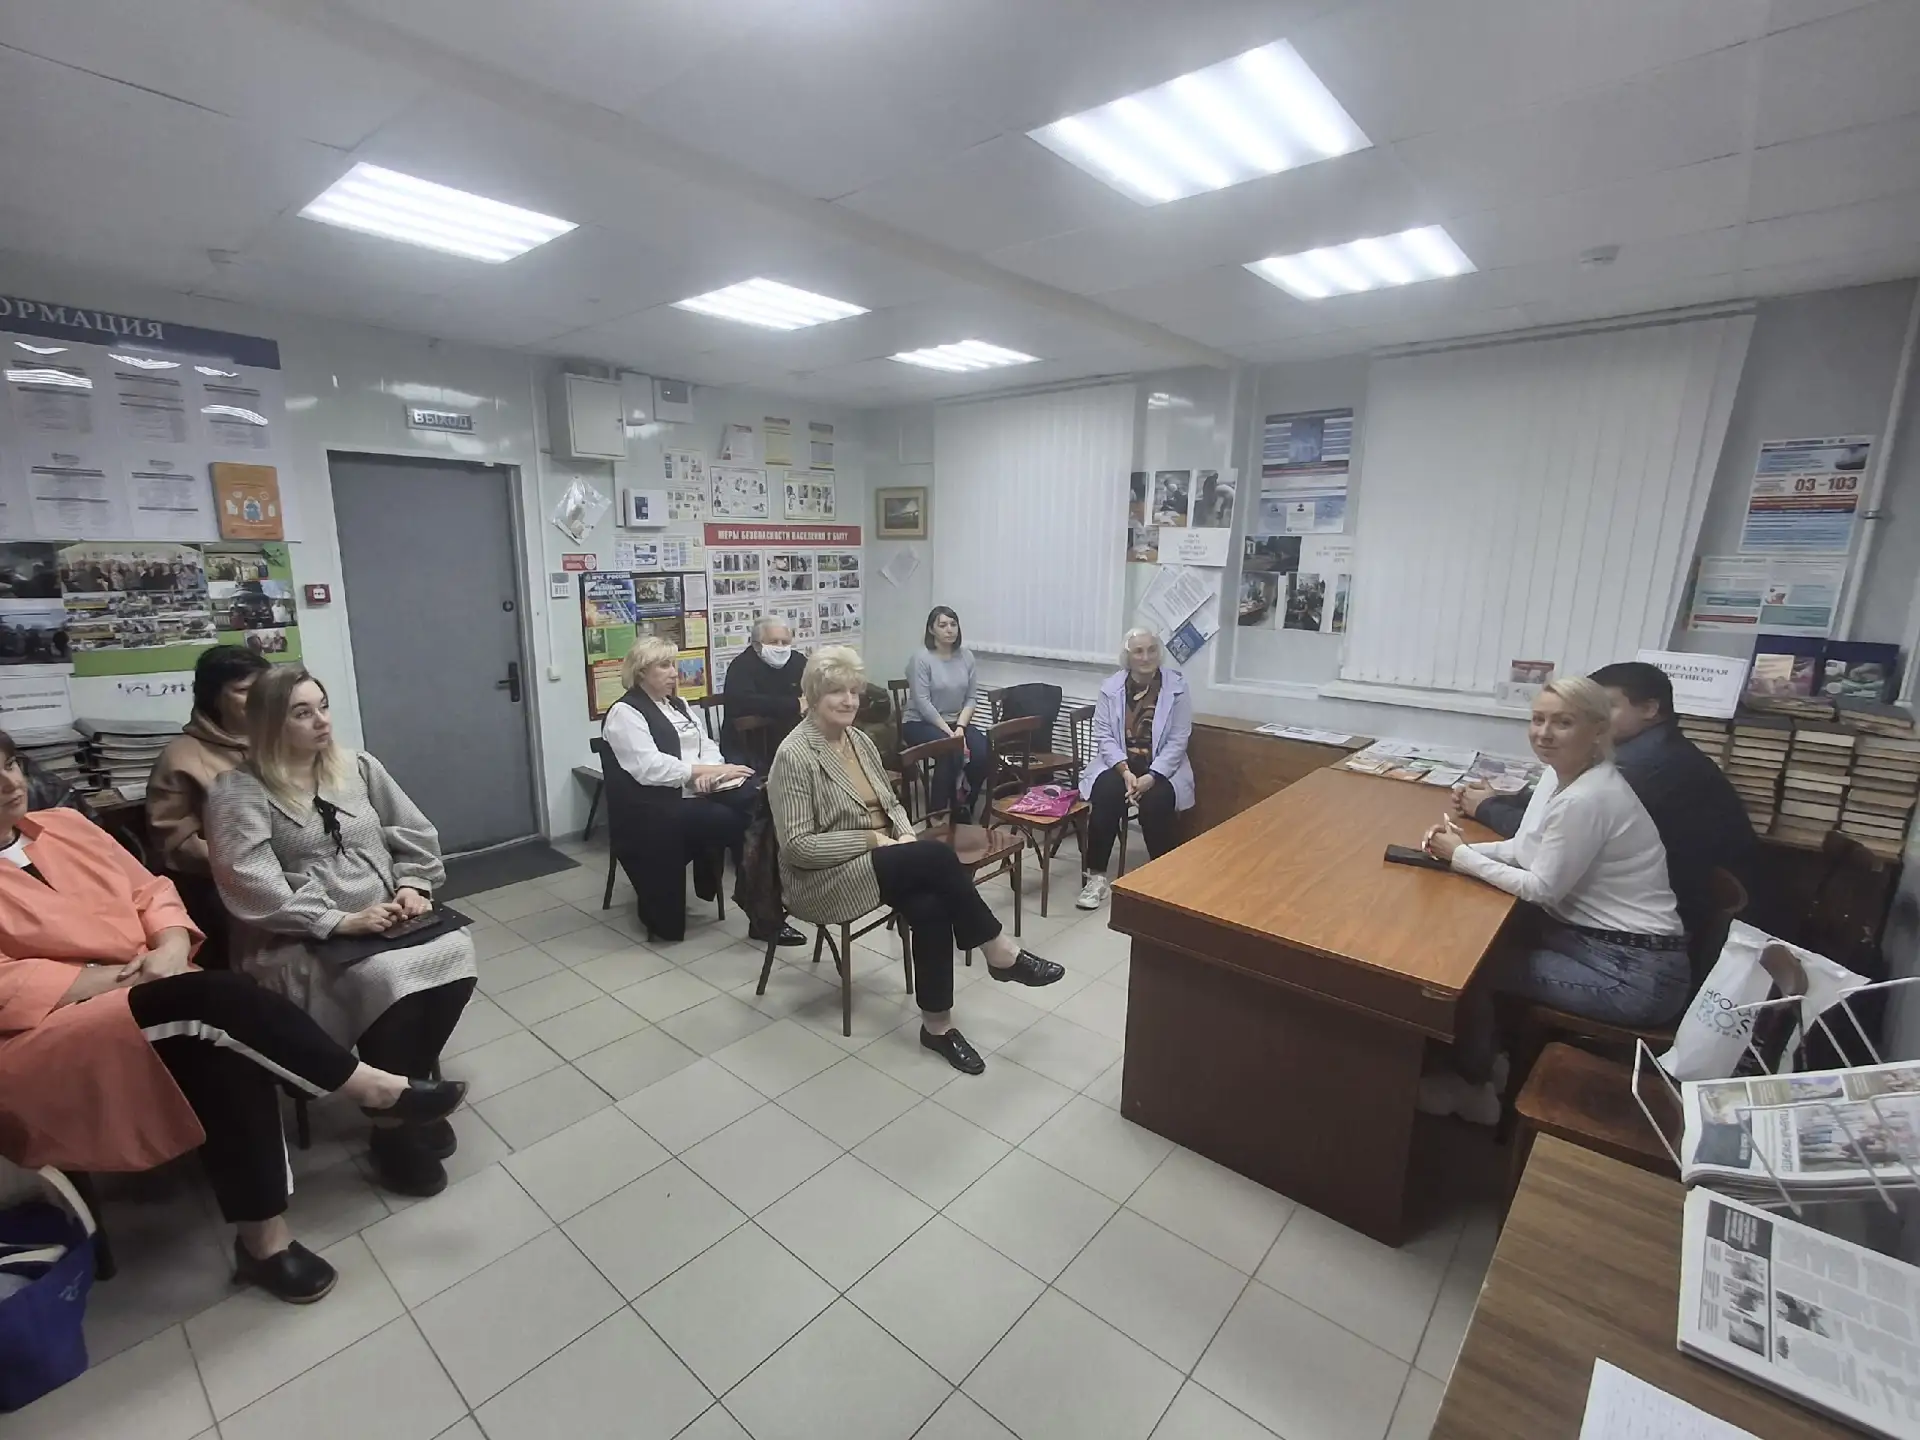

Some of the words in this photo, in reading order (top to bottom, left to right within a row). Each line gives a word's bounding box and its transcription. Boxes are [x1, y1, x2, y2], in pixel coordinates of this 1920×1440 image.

[413, 411, 469, 428] ВЫХОД
[717, 530, 740, 540] МЕРЫ
[741, 530, 791, 541] БЕЗОПАСНОСТИ
[791, 531, 826, 541] НАСЕЛЕНИЯ
[1666, 671, 1713, 683] ОСТИНАЯ
